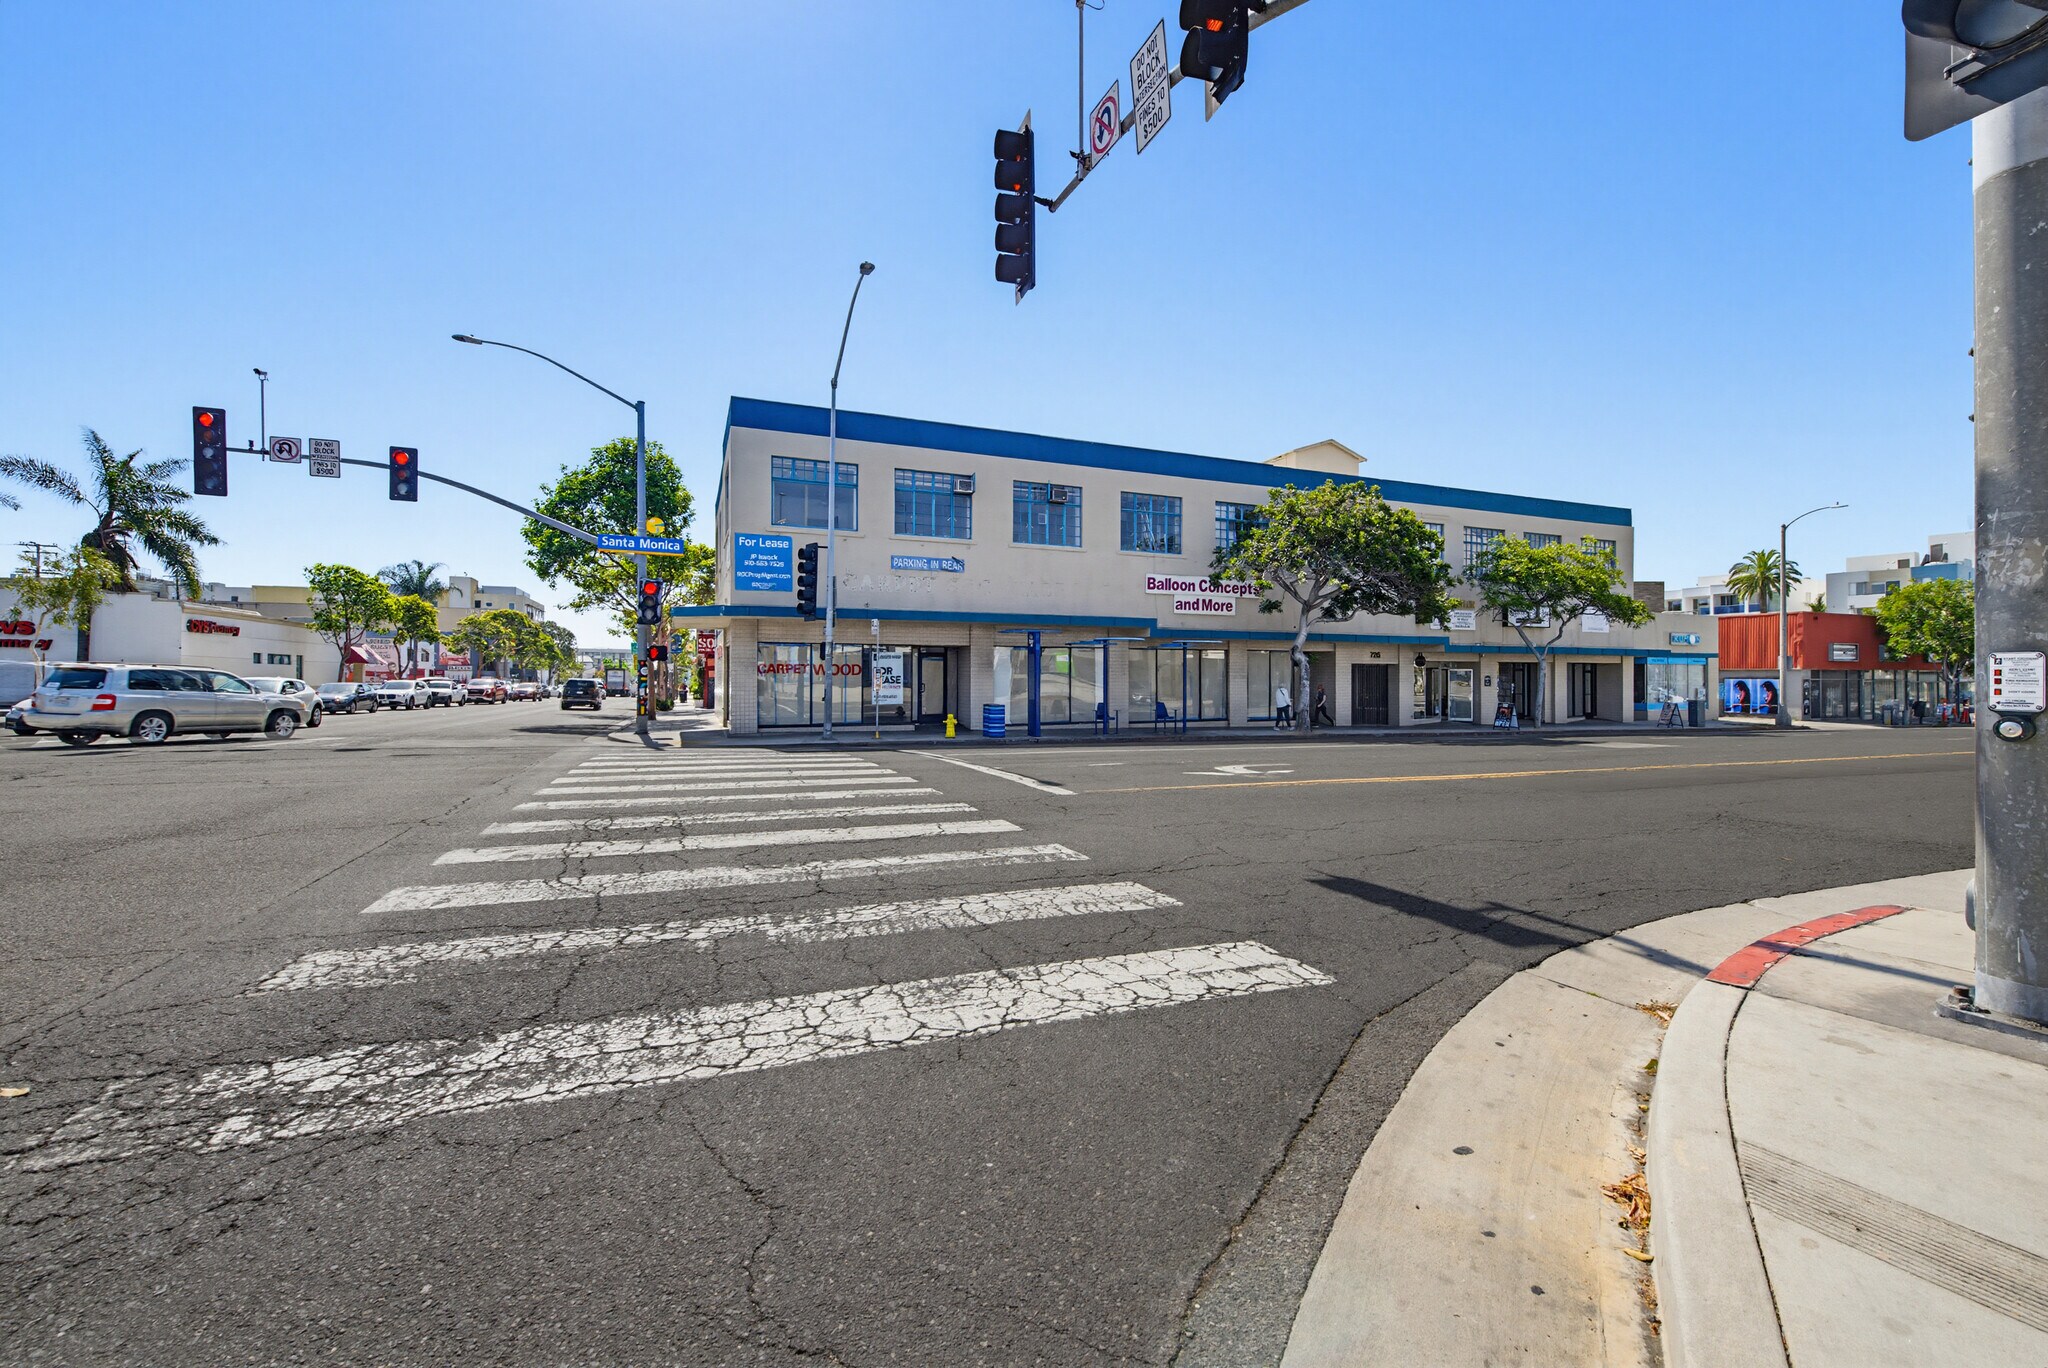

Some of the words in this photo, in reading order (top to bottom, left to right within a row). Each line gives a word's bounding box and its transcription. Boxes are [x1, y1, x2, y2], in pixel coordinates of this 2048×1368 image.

[1137, 53, 1145, 70] DO
[1147, 35, 1158, 57] NOT
[1137, 50, 1160, 89] BLOCK
[1135, 63, 1166, 106] INTERSECTION
[1139, 97, 1155, 125] FINES
[1157, 87, 1165, 100] TO
[1143, 106, 1163, 139] $500
[602, 536, 635, 548] Santa
[640, 539, 680, 550] Monica
[739, 537, 756, 546] For
[759, 538, 789, 548] Lease
[893, 557, 928, 568] PARKING
[931, 560, 939, 569] IN
[1147, 577, 1196, 592] Balloon
[1175, 598, 1200, 612] and
[1202, 599, 1233, 612] More
[0, 620, 36, 635] VS
[757, 663, 810, 675] CARPET
[813, 664, 862, 675] WOOD
